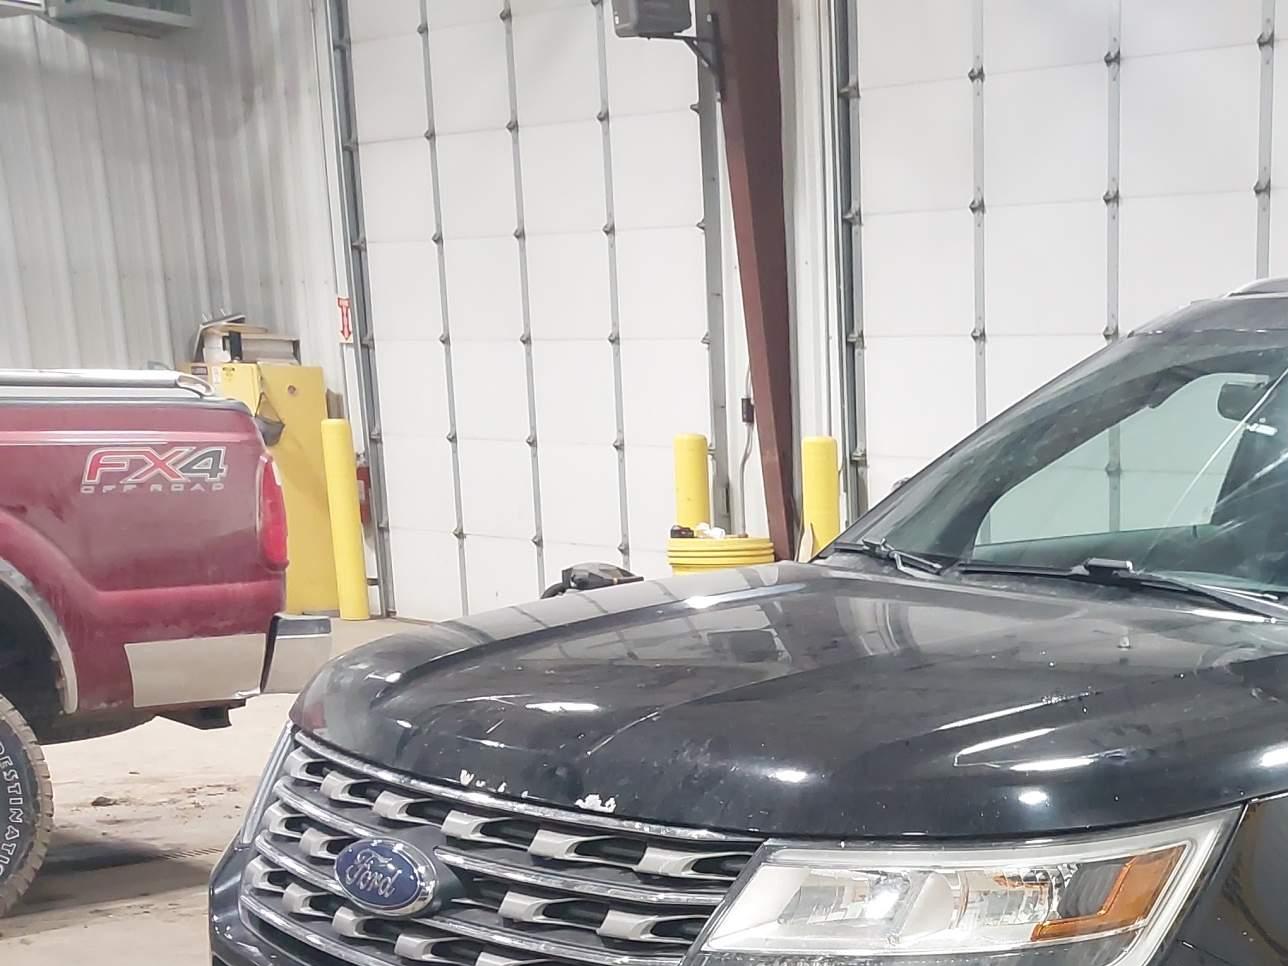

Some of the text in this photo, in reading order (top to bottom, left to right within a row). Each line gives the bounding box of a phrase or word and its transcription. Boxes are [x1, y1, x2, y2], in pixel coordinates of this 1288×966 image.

[82, 447, 228, 484] FX4
[80, 483, 225, 494] OFF ROAD
[345, 849, 403, 898] Ford
